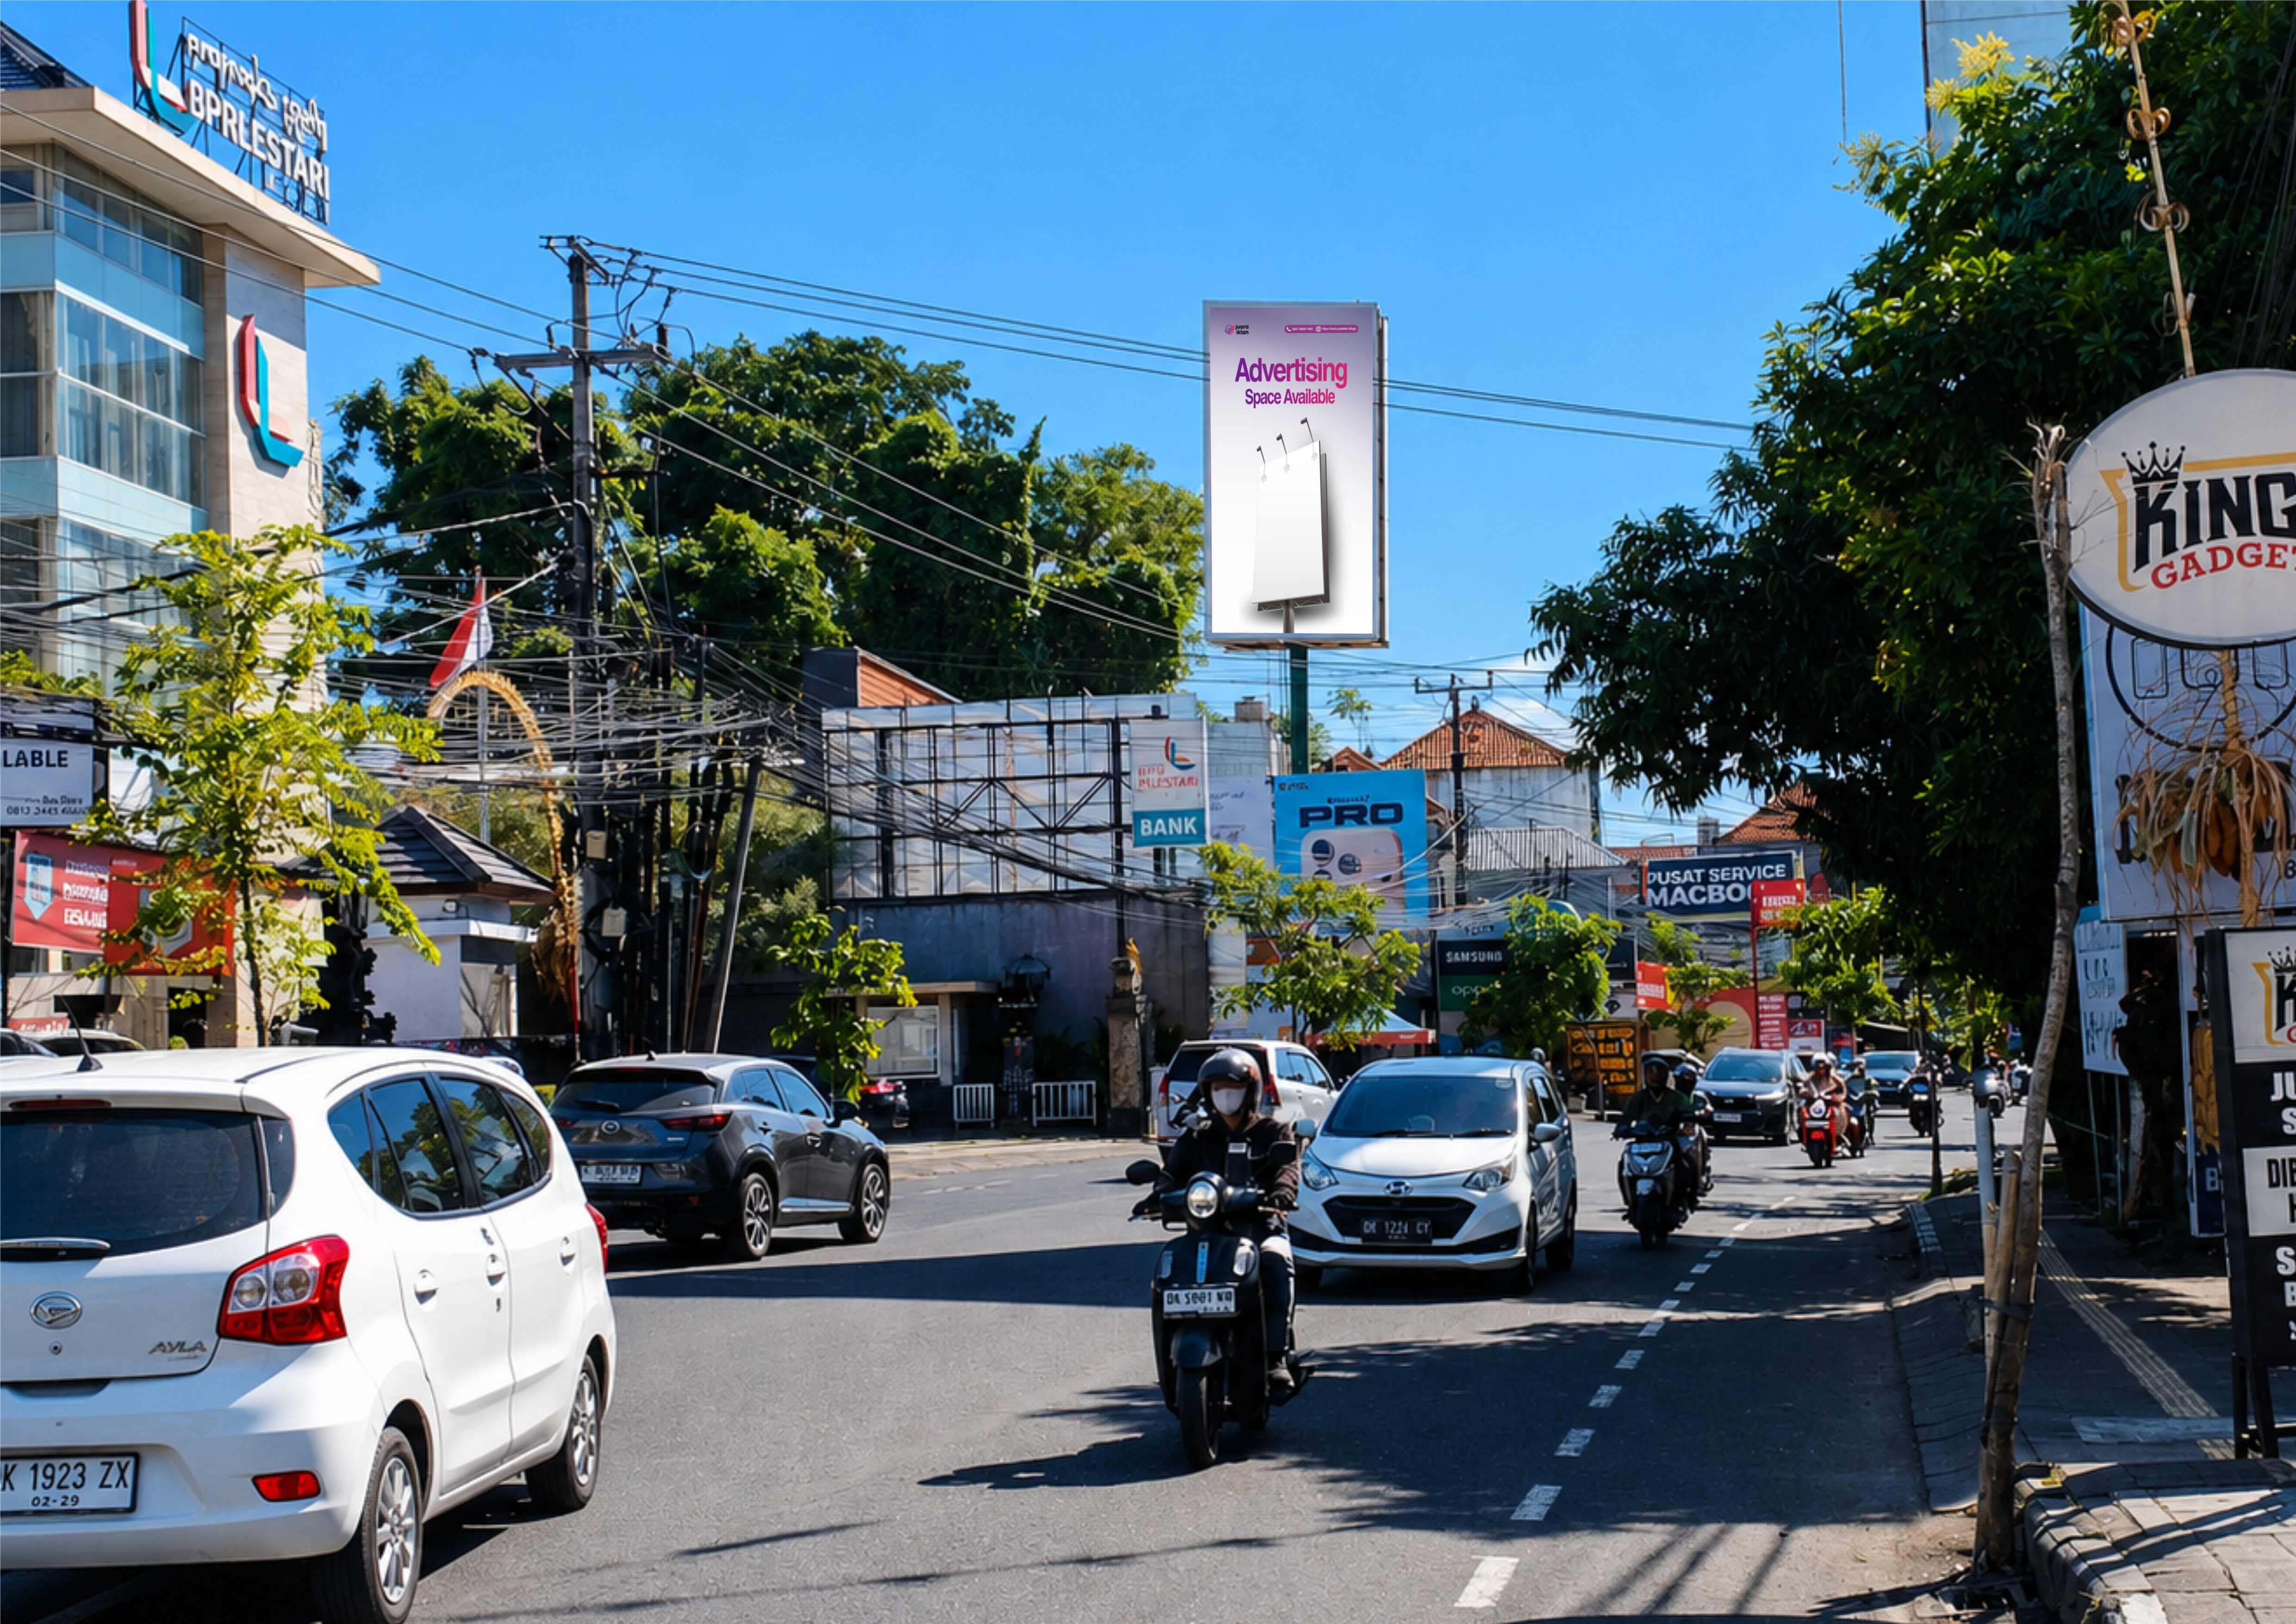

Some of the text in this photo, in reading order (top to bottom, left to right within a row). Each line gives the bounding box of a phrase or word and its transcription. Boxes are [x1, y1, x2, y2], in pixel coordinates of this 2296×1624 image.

[1234, 357, 1348, 388] Advertising
[1245, 388, 1336, 408] Space Available
[2151, 542, 2296, 589] GADGE
[3, 750, 68, 768] LABLE
[1299, 802, 1403, 828] PRO
[1140, 817, 1197, 837] BANK
[1709, 864, 1786, 882] SERVICE
[1446, 950, 1503, 963] SAMSUNG
[148, 1340, 207, 1355] AYLA
[30, 1462, 87, 1491] 1923
[98, 1461, 131, 1489] ZX
[31, 1495, 79, 1507] 02-29
